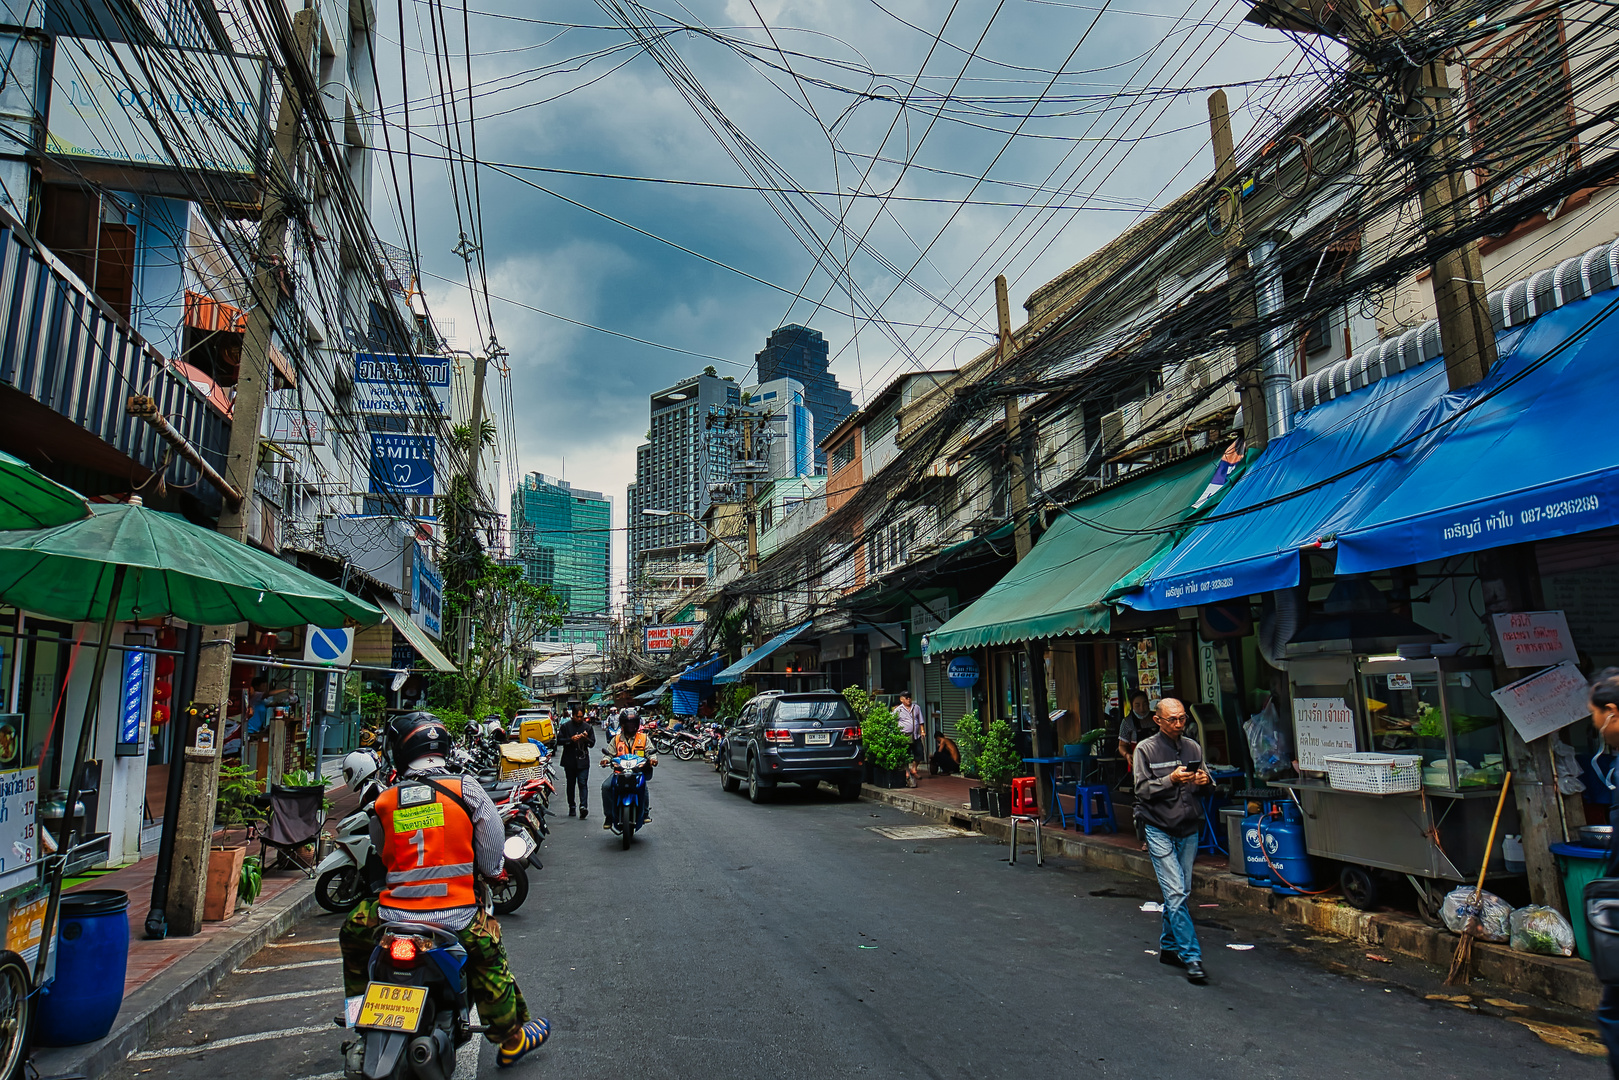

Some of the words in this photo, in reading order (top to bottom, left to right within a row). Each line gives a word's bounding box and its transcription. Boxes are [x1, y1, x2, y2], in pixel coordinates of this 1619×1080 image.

[375, 445, 431, 460] SMILE
[1444, 517, 1482, 540] เจริญดี
[1520, 494, 1599, 524] 087-9236289
[1200, 577, 1234, 592] 087-9236289
[648, 629, 668, 638] PRINCE
[669, 627, 694, 637] THEATRE
[1298, 702, 1323, 722] บางรัก
[26, 776, 36, 793] 15
[24, 801, 35, 816] 17
[24, 823, 35, 840] 15
[25, 847, 32, 863] 8
[408, 829, 425, 867] 1
[374, 1013, 405, 1028] 746
